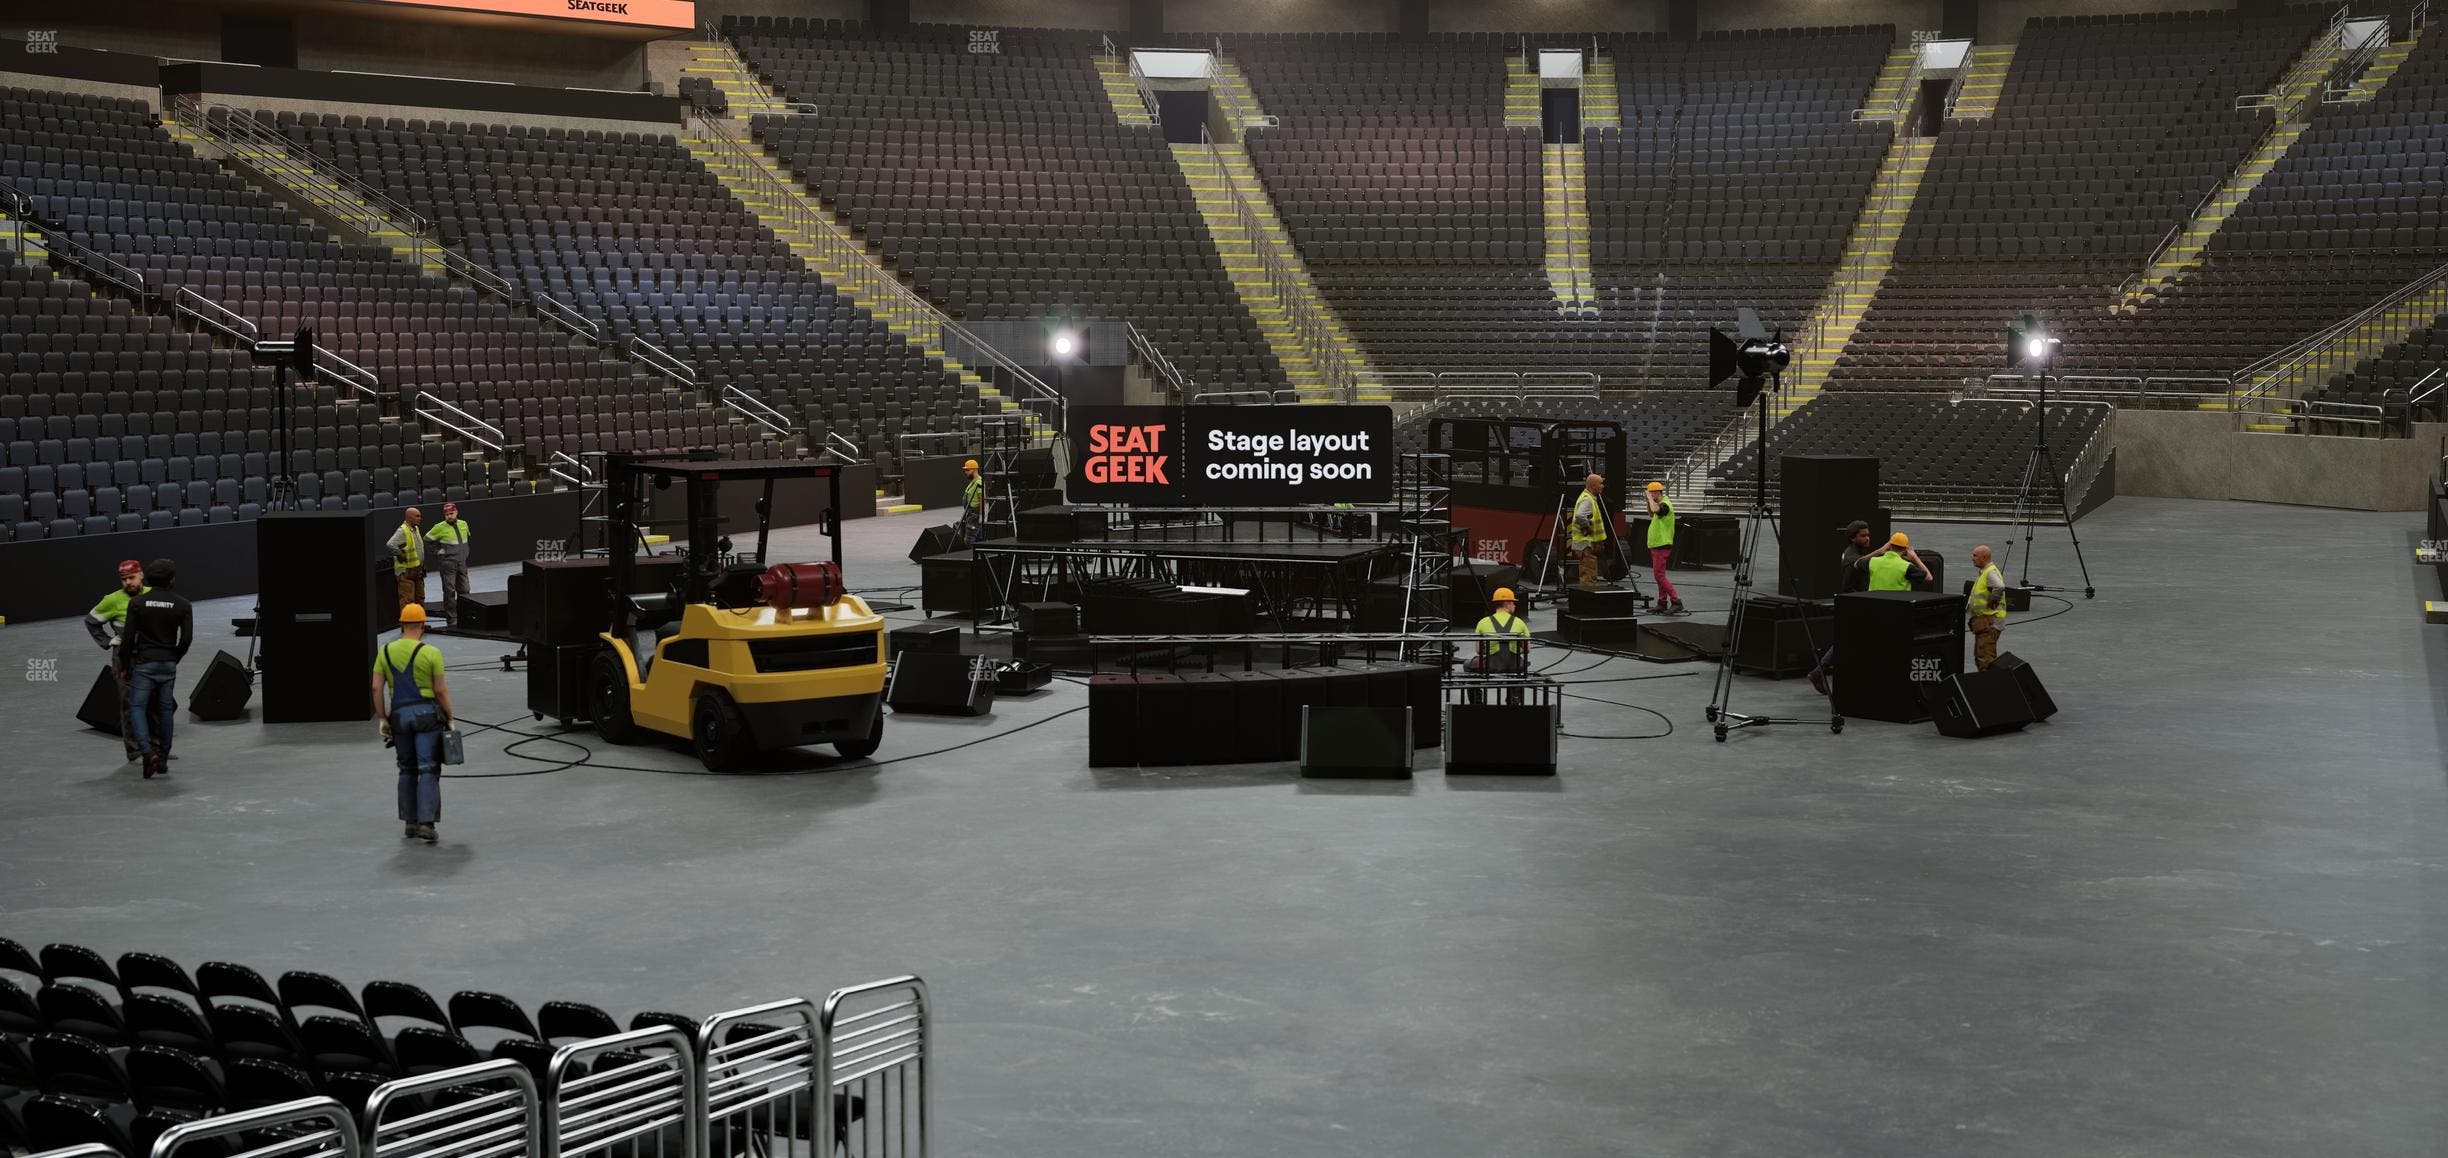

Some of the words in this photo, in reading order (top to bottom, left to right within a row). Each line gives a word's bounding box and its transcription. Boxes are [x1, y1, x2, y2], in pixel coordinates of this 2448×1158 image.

[567, 0, 628, 15] SEATGEEK
[1089, 424, 1167, 453] SEAT
[1208, 429, 1284, 456] Stage
[1290, 429, 1370, 456] layout
[1084, 455, 1170, 485] GEEK
[1205, 457, 1303, 485] coming
[1310, 463, 1372, 480] soon
[145, 600, 175, 608] SECURITY
